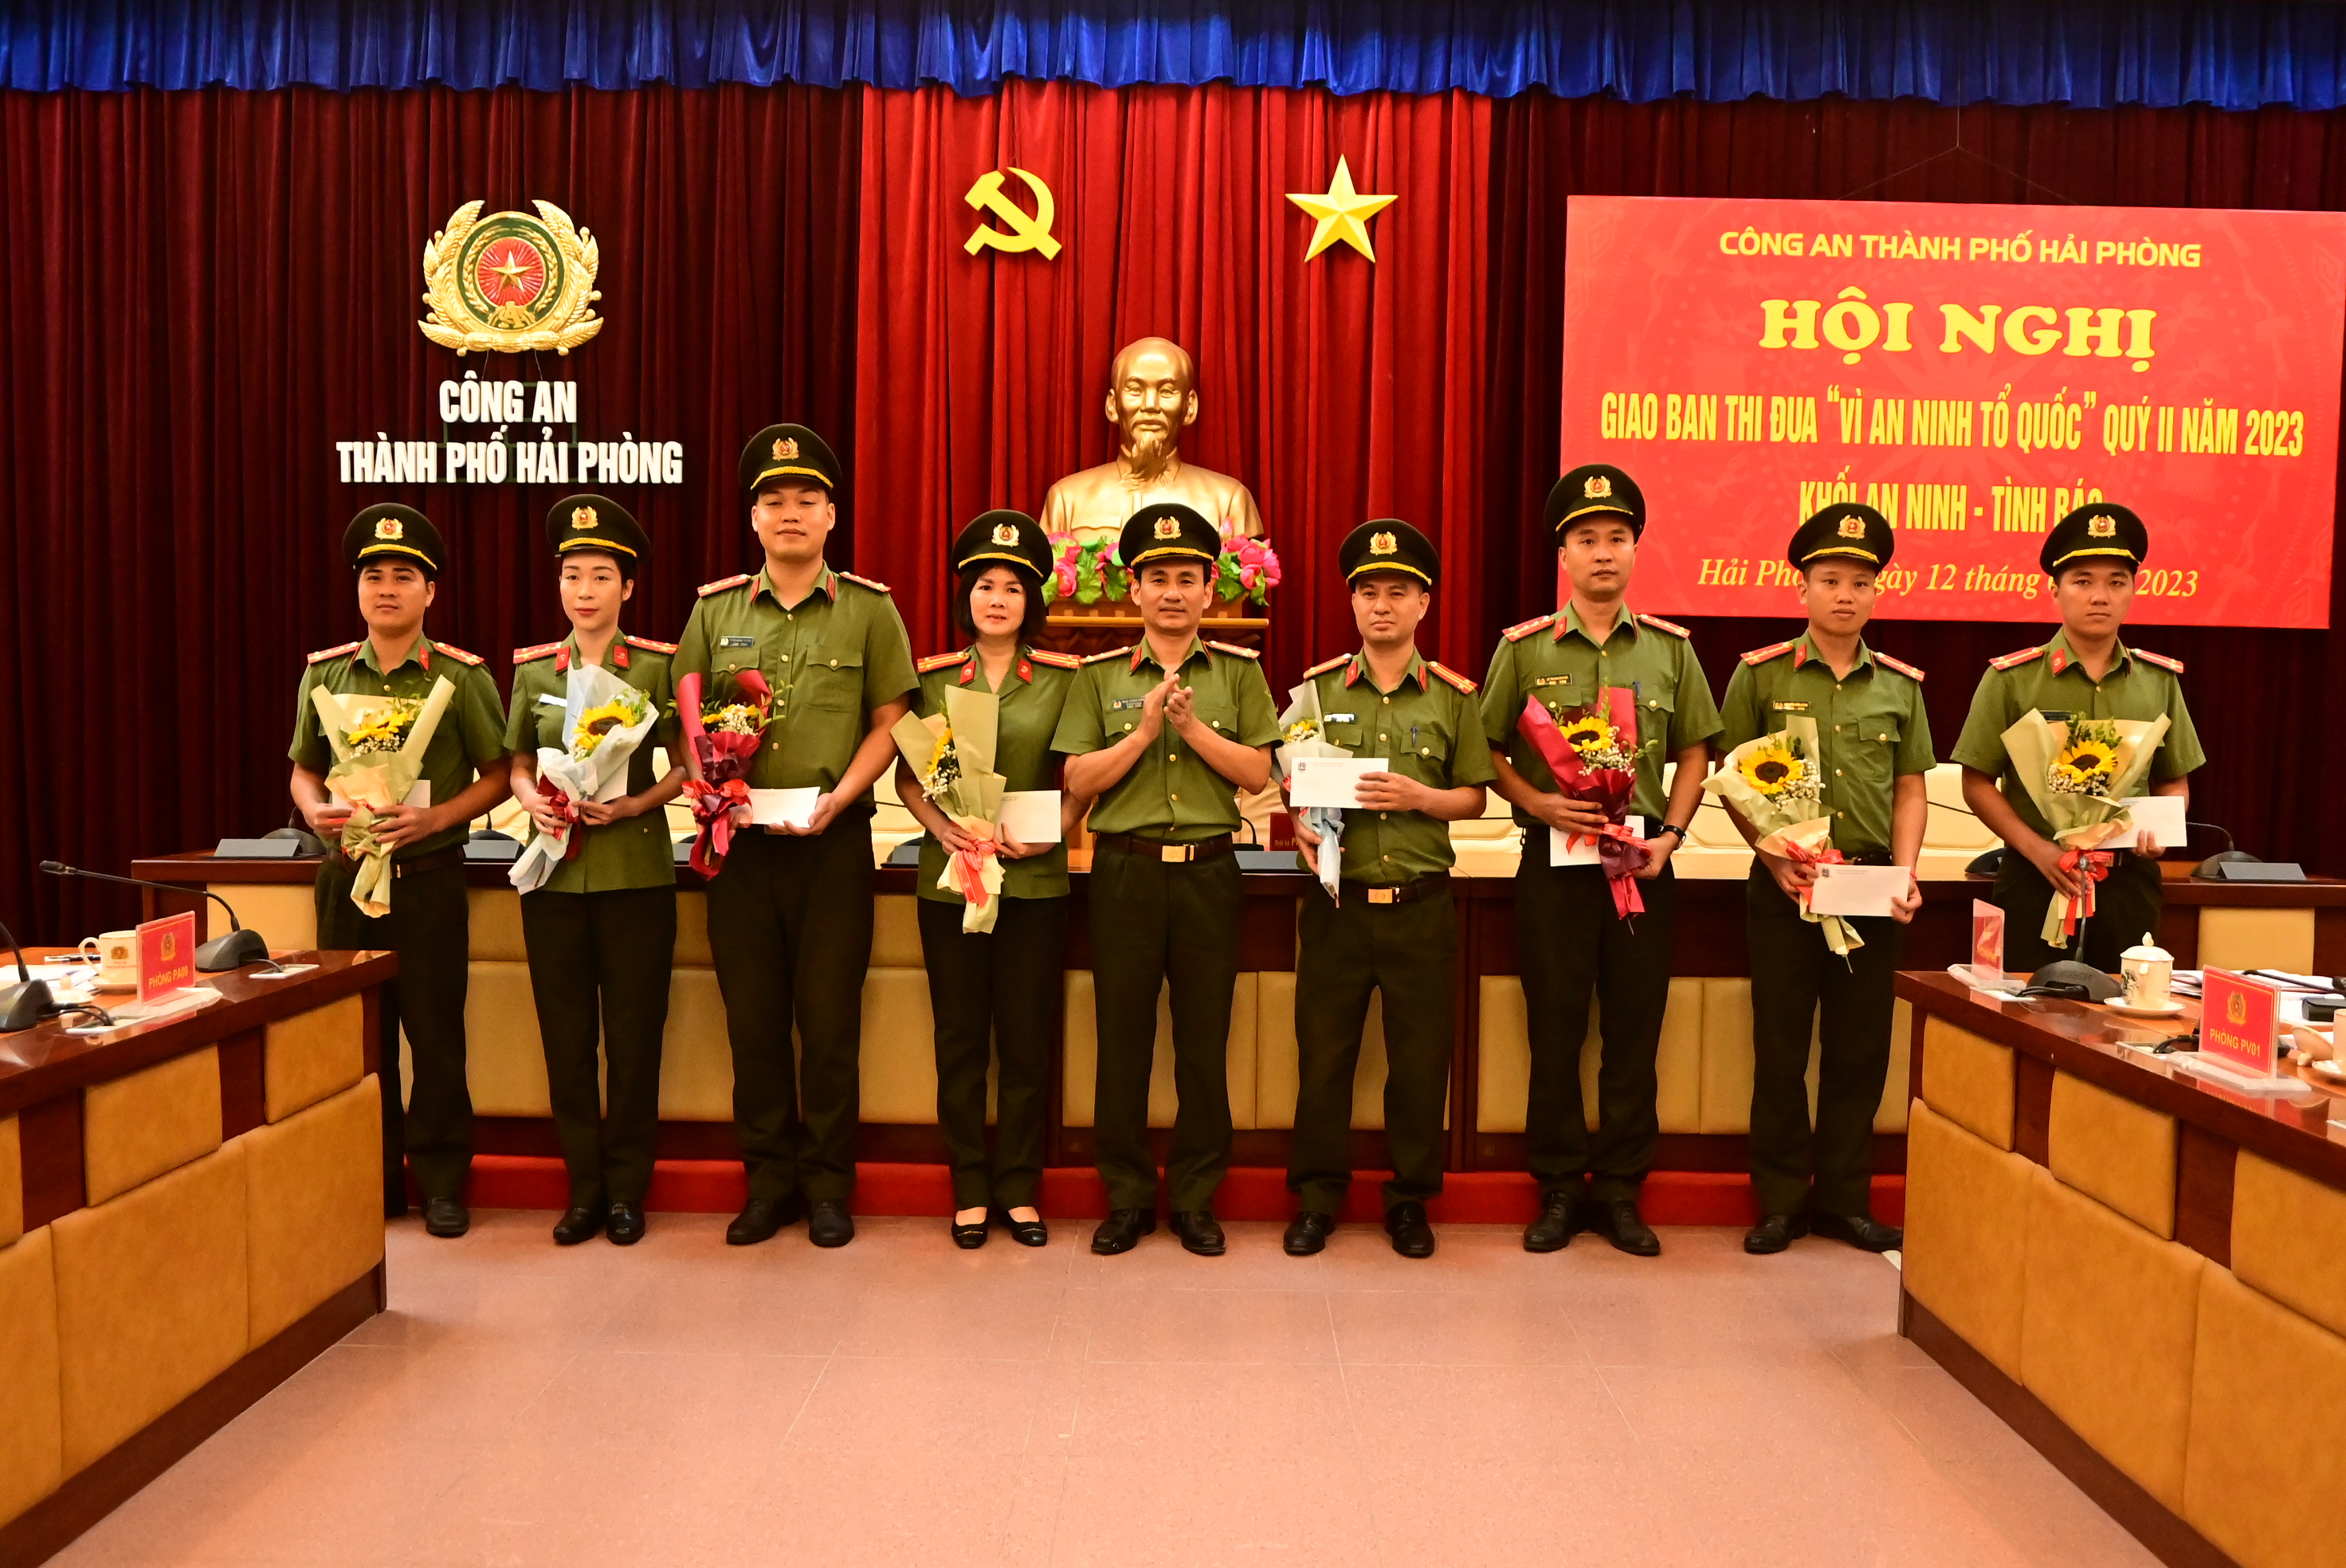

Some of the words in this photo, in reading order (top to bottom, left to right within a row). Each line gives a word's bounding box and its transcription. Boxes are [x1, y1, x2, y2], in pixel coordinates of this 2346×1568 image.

[1720, 226, 1804, 257] CÔNG
[1809, 233, 1853, 257] AN
[1860, 229, 1961, 261] THÀNH
[1969, 229, 2034, 263] PHỐ
[2039, 233, 2088, 265] HẢI
[2096, 237, 2202, 268] PHÒNG
[1758, 285, 1914, 365] HỘI
[1939, 304, 2157, 373] NGHỊ
[439, 370, 525, 423] CÔNG
[532, 381, 577, 423] AN
[1601, 392, 1658, 441] GIAO
[1665, 394, 1717, 441] BAN
[1724, 394, 1763, 441] THI
[1769, 395, 1818, 443] ĐUA
[1869, 398, 1905, 445] AN
[1911, 399, 1973, 447] NINH
[1979, 382, 2012, 449] TỔ
[2103, 395, 2152, 457] QUÝ
[2157, 406, 2175, 453] II
[2180, 397, 2238, 454] NĂM
[2244, 409, 2304, 457] 2023
[335, 431, 437, 484] THÀNH
[446, 425, 508, 484] PHỐ
[516, 426, 569, 484] HẢI
[578, 431, 683, 484] PHÒNG
[1905, 484, 1967, 531] NINH
[1991, 476, 2047, 533] TÌNH
[1697, 558, 1748, 586] Hải
[1873, 562, 1918, 596] gày
[1925, 563, 1957, 590] 12
[1964, 564, 2041, 599] tháng
[2134, 569, 2199, 597] 2023
[148, 971, 172, 990] PHÒNG
[2210, 1028, 2239, 1050] PHÒNG
[2240, 1039, 2261, 1058] PV01
